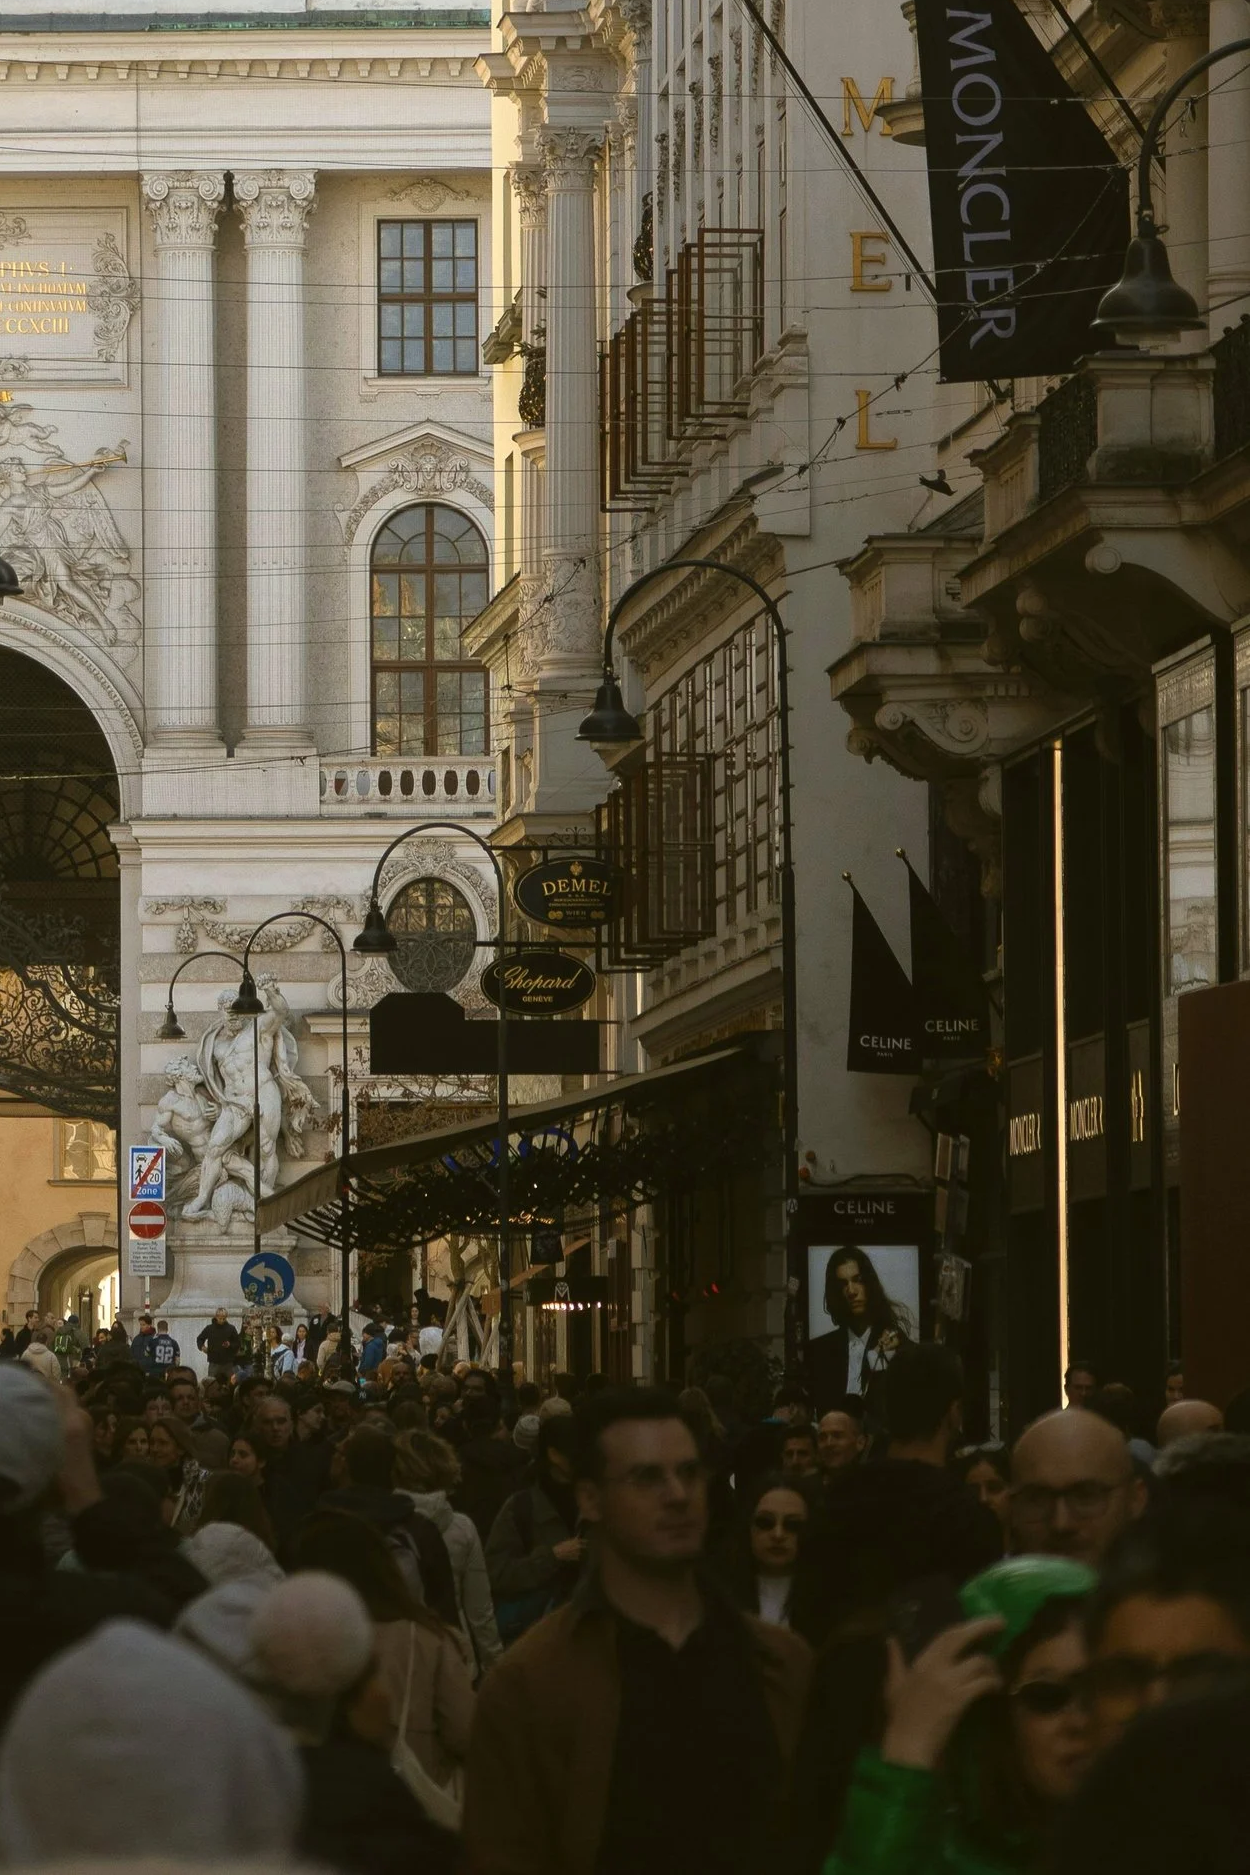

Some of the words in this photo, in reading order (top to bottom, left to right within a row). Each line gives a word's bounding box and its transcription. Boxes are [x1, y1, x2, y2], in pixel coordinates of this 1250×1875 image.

[946, 8, 1017, 351] MONCLER
[542, 878, 612, 896] DEMEL
[493, 966, 583, 994] Chopard
[924, 1019, 980, 1033] CELINE
[859, 1035, 912, 1051] CELINE
[149, 1173, 160, 1183] 20
[136, 1186, 159, 1196] Zone
[833, 1200, 896, 1215] CELINE
[155, 1345, 174, 1364] 92
